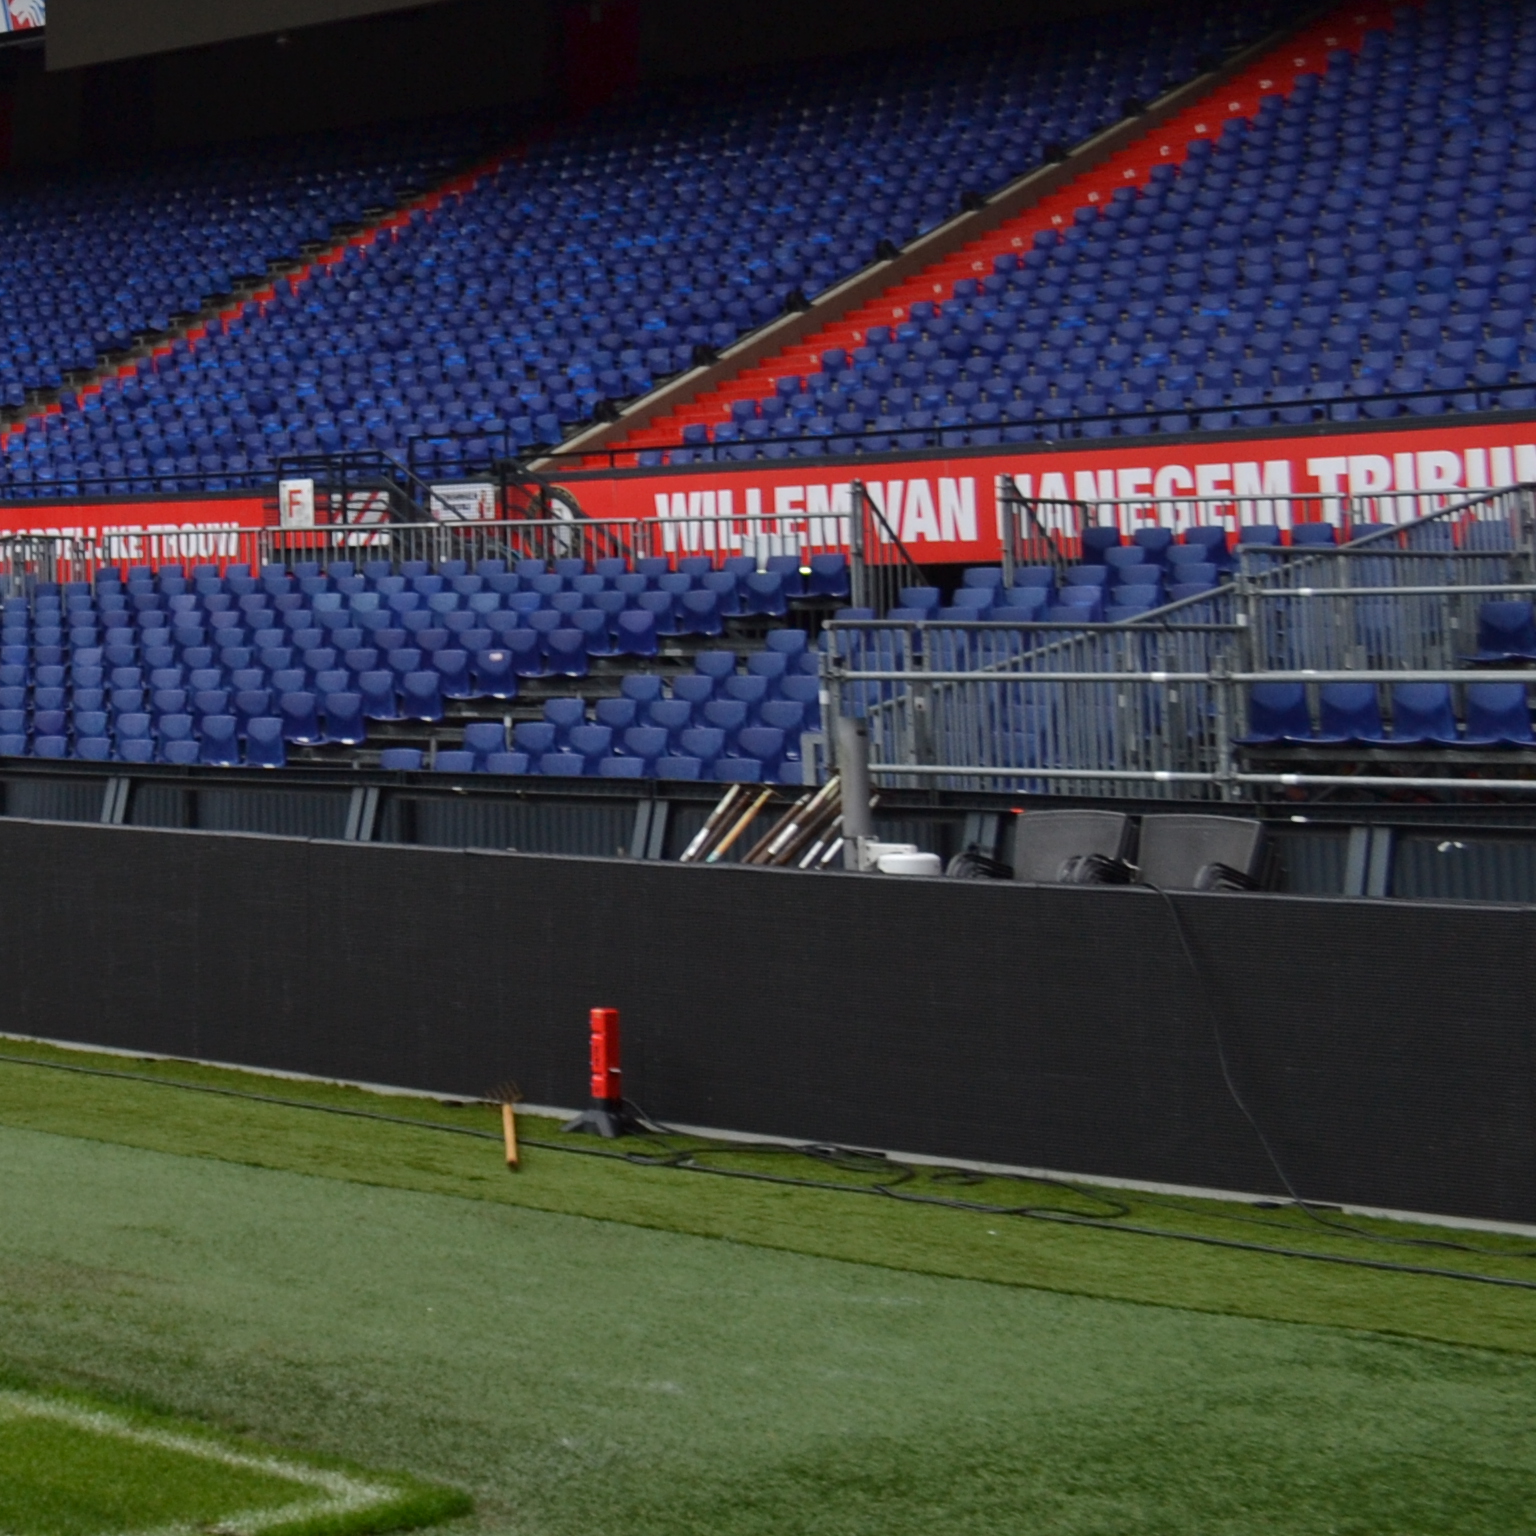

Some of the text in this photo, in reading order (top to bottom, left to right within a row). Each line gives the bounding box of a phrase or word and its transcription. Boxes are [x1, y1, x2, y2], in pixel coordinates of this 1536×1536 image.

[288, 489, 303, 518] F
[655, 482, 853, 553] WILLEM
[865, 476, 978, 544] VAN
[995, 459, 1293, 542] HANEGEM
[147, 521, 240, 560] TROUW
